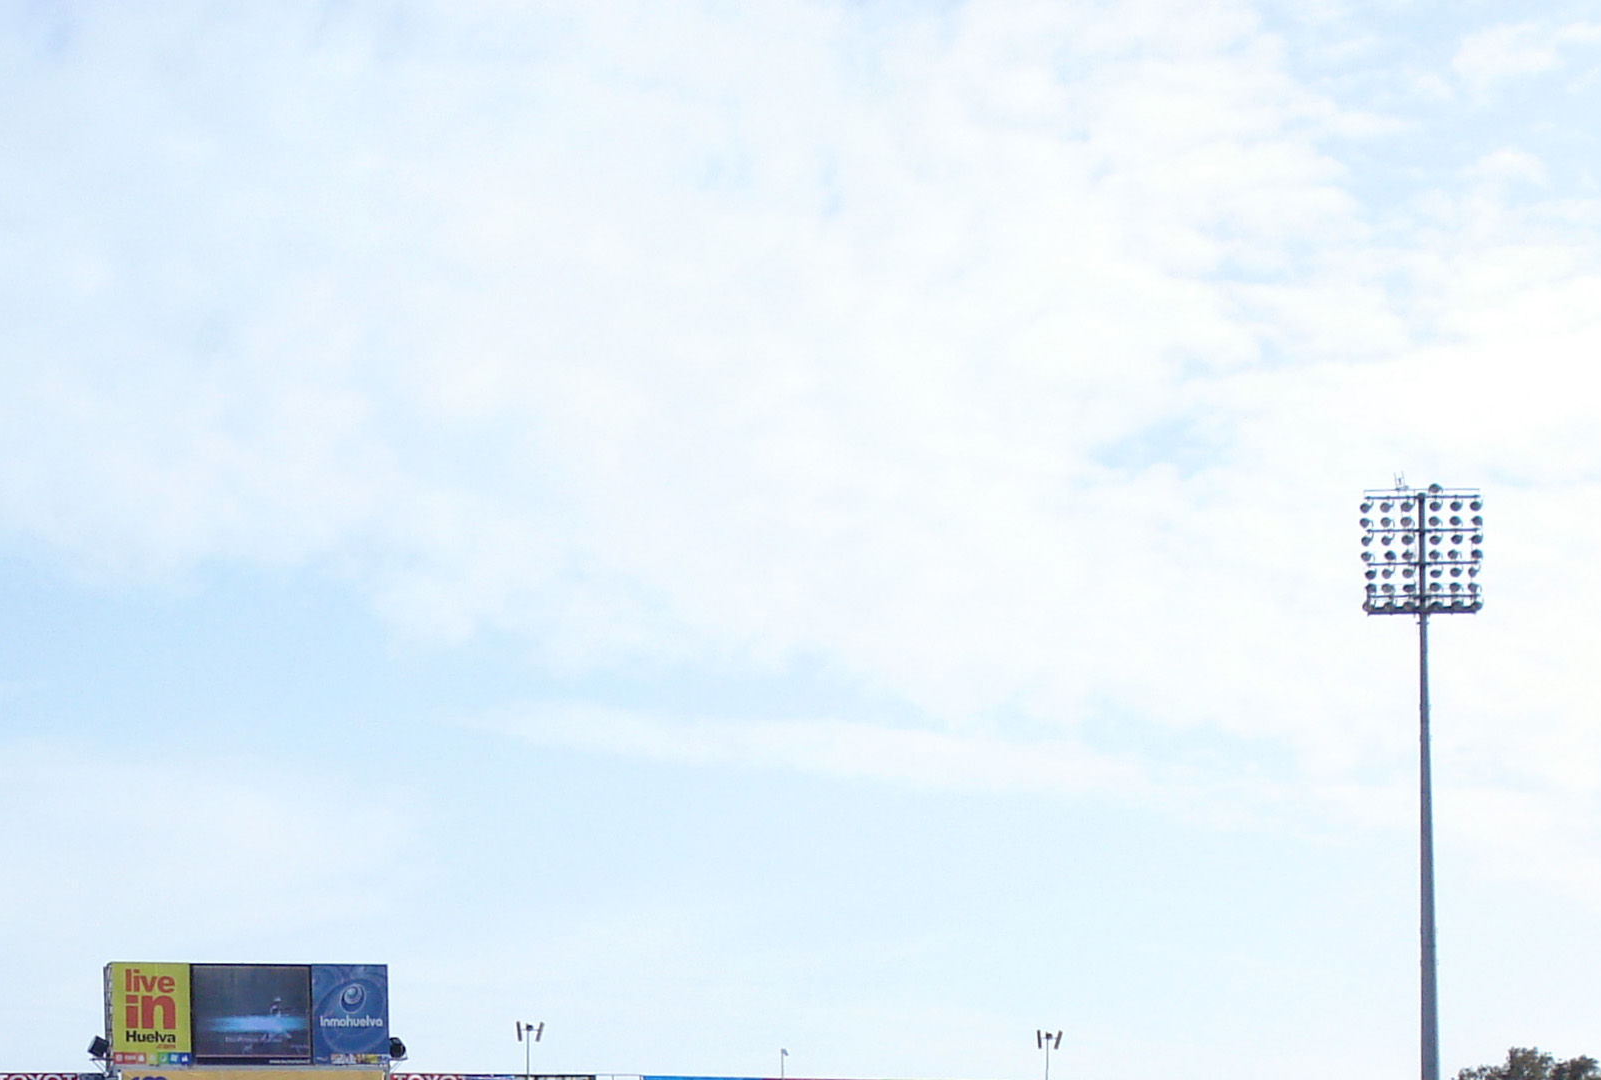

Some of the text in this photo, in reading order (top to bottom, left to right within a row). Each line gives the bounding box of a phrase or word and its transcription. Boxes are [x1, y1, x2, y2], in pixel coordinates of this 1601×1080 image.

[125, 969, 176, 993] live
[125, 994, 176, 1030] in
[320, 1015, 383, 1028] Inmohuelva
[125, 1030, 176, 1043] Huelva
